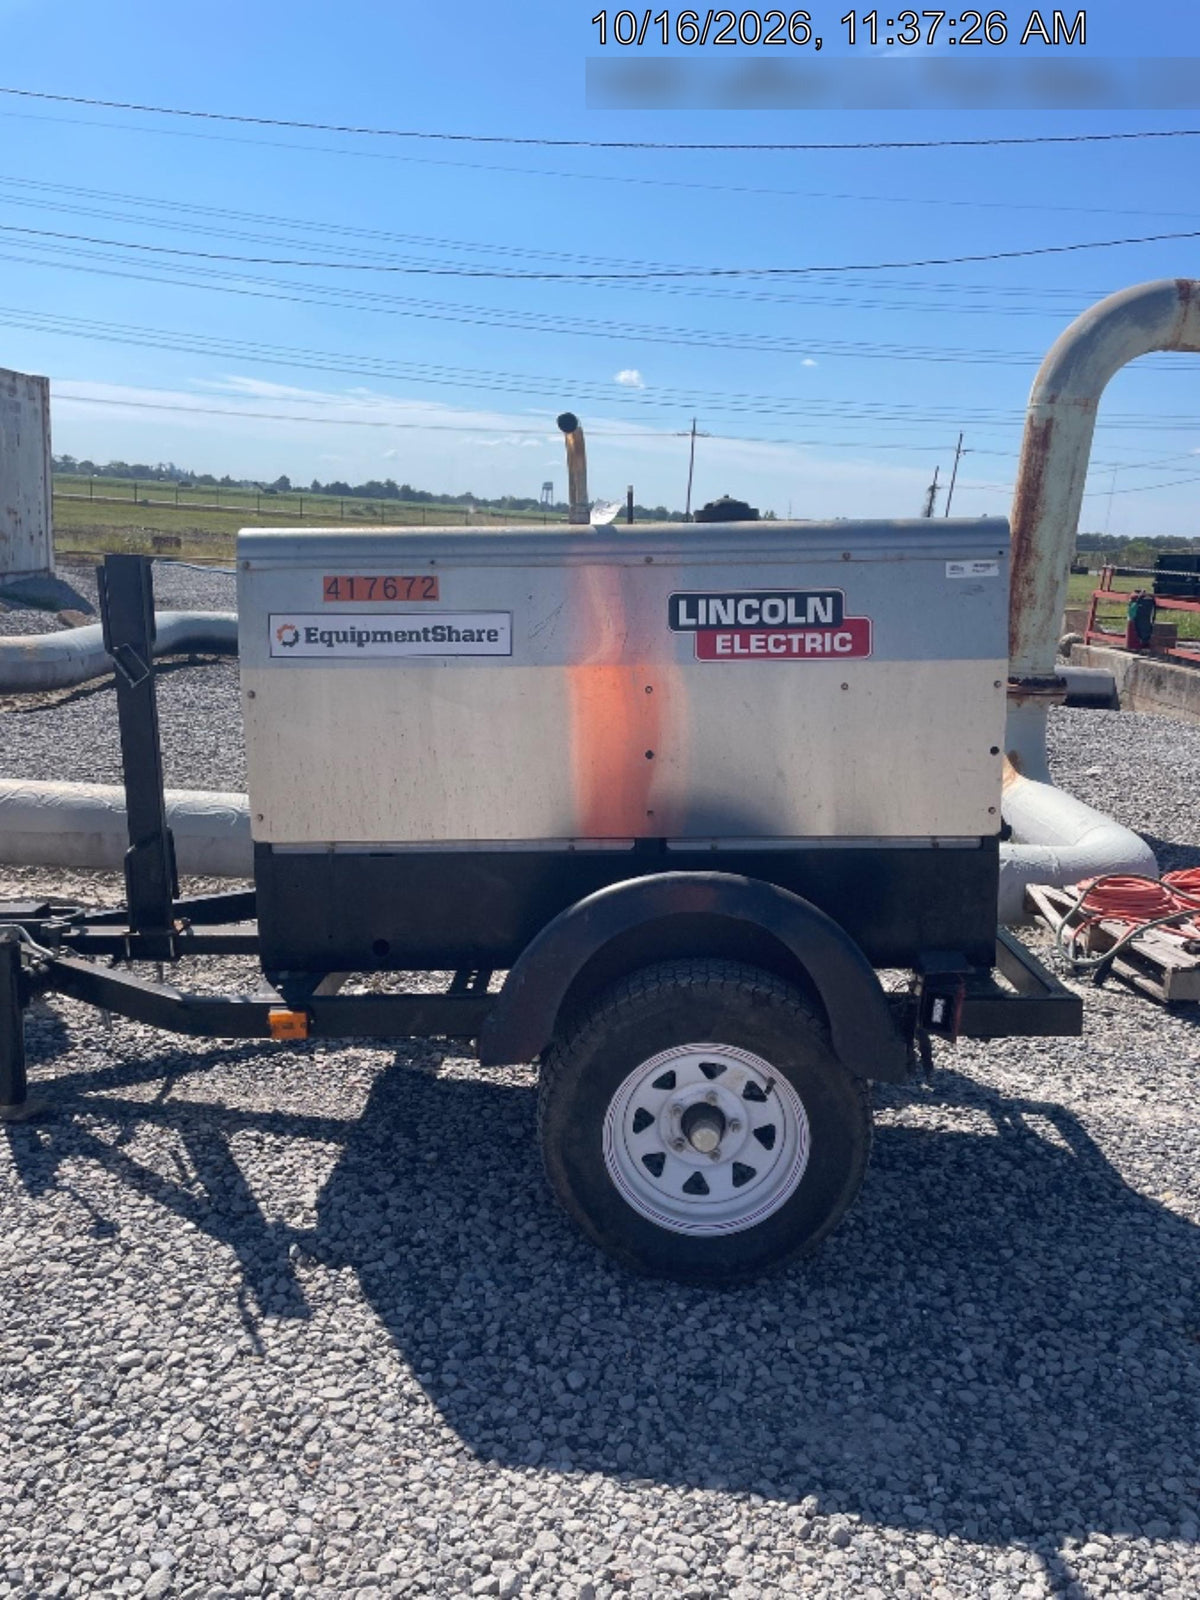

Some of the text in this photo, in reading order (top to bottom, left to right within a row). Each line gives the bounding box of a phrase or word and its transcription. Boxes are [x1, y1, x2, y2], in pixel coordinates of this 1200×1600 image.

[326, 576, 437, 600] 417672
[678, 597, 833, 626] LINCOLN
[304, 625, 499, 648] EquipmentShare
[716, 632, 853, 655] ELECTRIC
